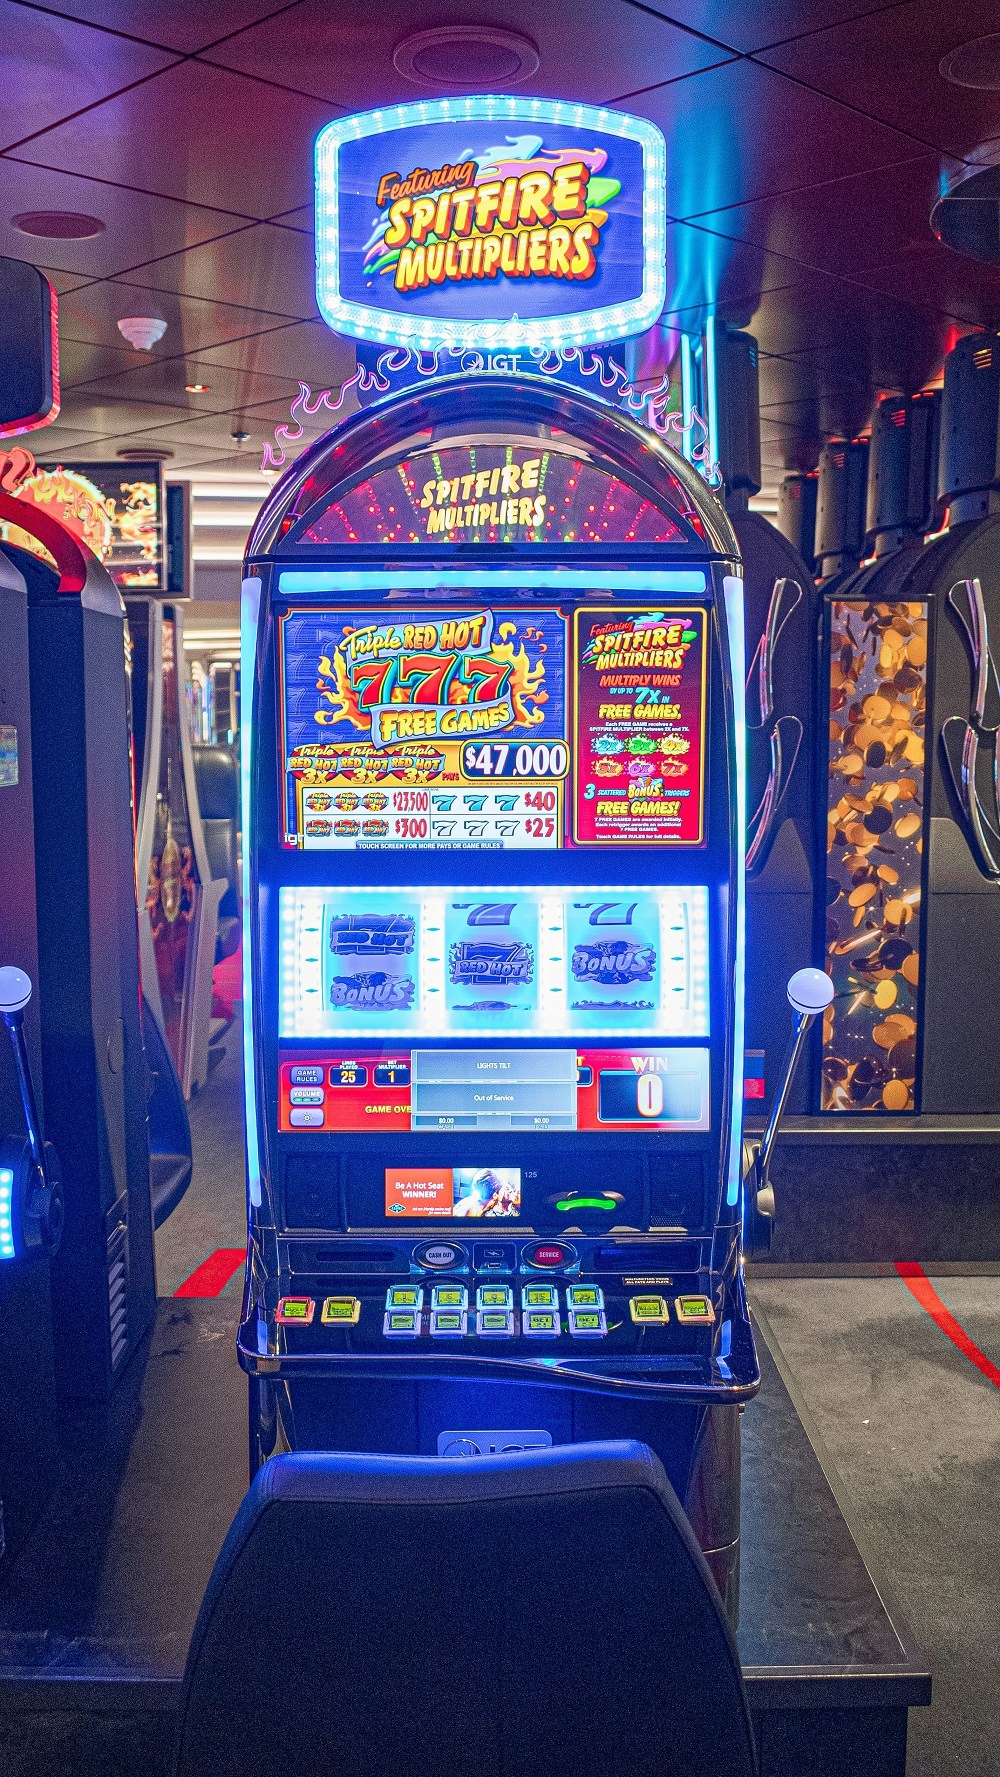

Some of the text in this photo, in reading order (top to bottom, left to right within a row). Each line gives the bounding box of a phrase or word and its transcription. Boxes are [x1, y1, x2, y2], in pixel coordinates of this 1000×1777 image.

[378, 160, 474, 206] Featuring
[384, 162, 588, 246] SPITFIRE
[395, 222, 598, 291] MULTIPLIERS
[487, 354, 521, 372] IGT
[420, 459, 540, 508] SPITFIRE
[426, 495, 547, 534] MULTIPLIERS
[339, 616, 485, 660] Triple RED HOT
[590, 621, 634, 637] Featuring
[592, 624, 682, 653] SPITFIRE
[595, 649, 685, 671] MULTIPLIERS
[600, 675, 681, 687] MULTIPLY WINS
[599, 704, 682, 719] FREE GAMES.
[380, 702, 510, 742] FREE GAMES
[294, 744, 334, 757] Triple
[394, 744, 436, 757] Triple
[290, 758, 337, 771] RED HOT
[341, 758, 388, 771] RED HOT
[391, 758, 441, 771] RED HOT
[465, 744, 567, 776] $47,000
[442, 772, 460, 781] PAYS
[584, 783, 597, 800] 3
[664, 789, 690, 797] TRIGGERS
[525, 791, 555, 811] $40
[597, 801, 680, 814] FREE GAMES!
[395, 818, 427, 838] $300
[525, 818, 555, 837] $25
[459, 961, 523, 976] RED HOT
[631, 1056, 668, 1075] WIN
[341, 1071, 395, 1083] 25 1
[637, 1074, 663, 1117] 0
[395, 1181, 404, 1189] Be
[413, 1181, 427, 1189] Hot
[428, 1181, 444, 1189] Seat
